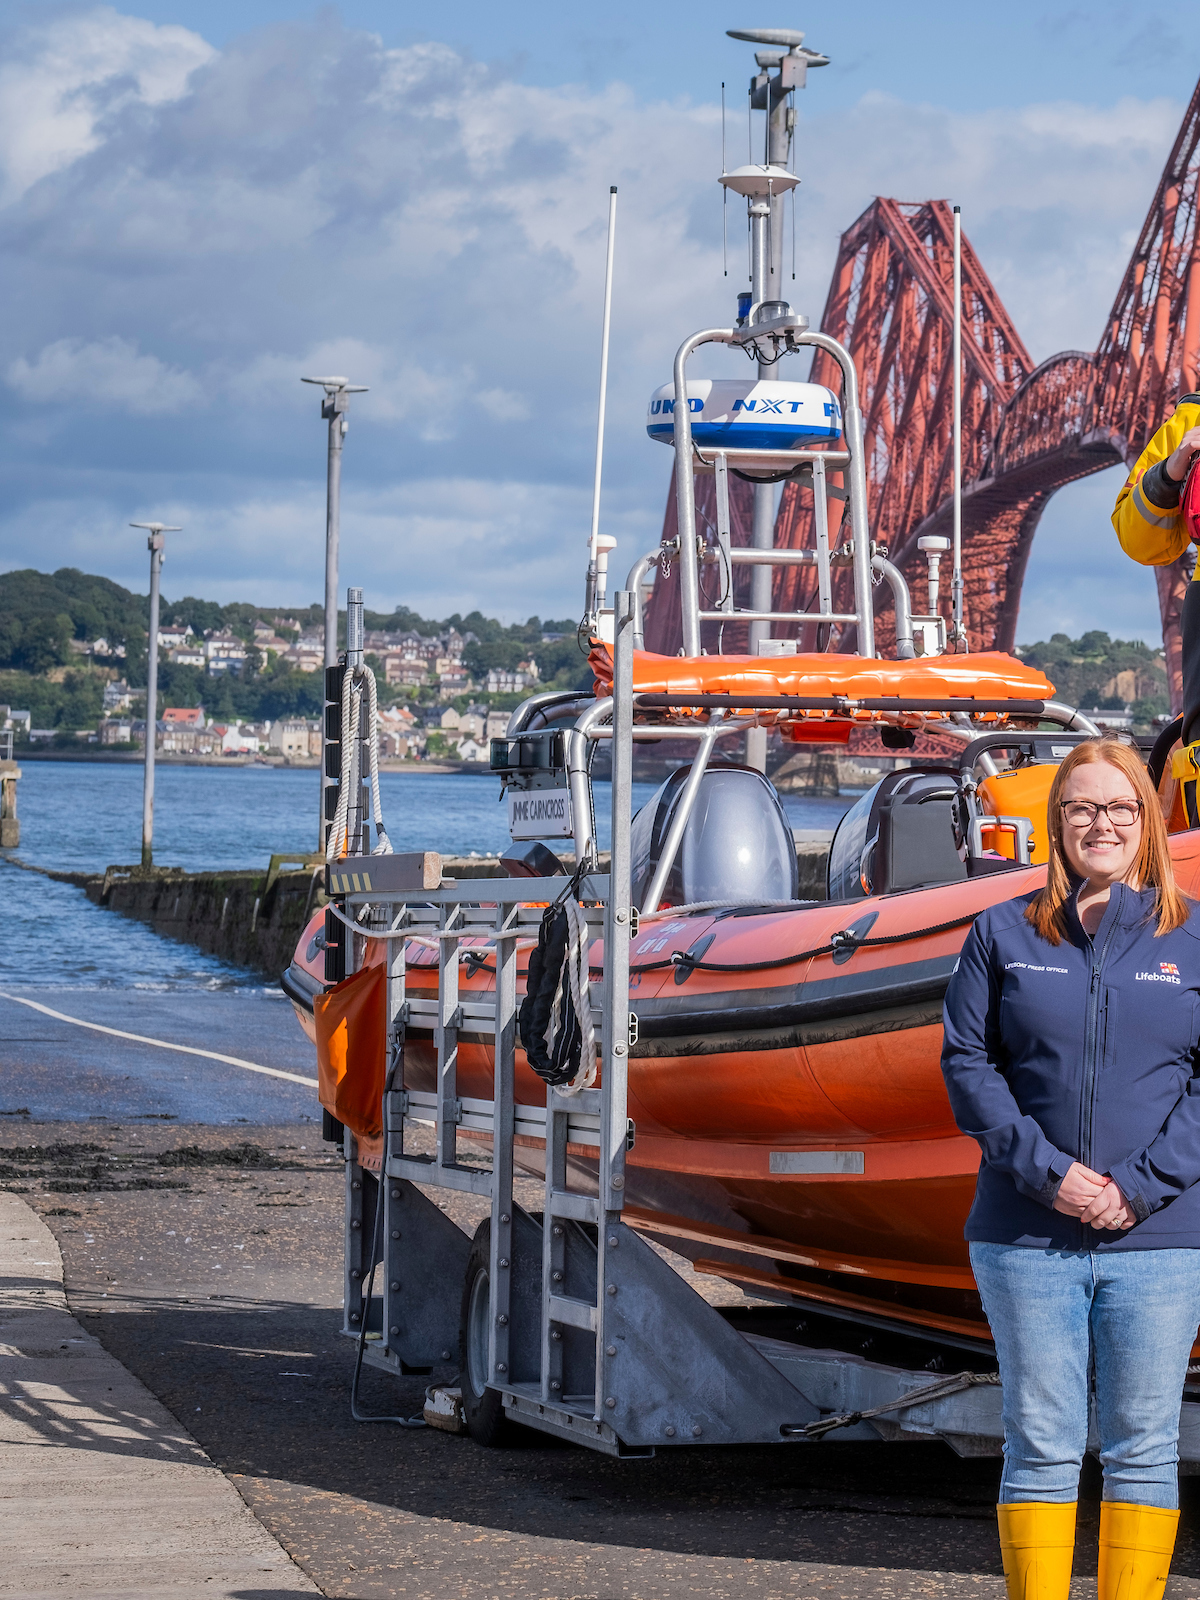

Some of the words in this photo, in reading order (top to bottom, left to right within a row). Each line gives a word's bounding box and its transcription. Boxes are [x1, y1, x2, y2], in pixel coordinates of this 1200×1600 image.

[651, 398, 704, 415] UNO
[731, 399, 804, 414] NXT
[1046, 966, 1069, 974] OFFICER
[1135, 972, 1181, 984] Lifeboats
